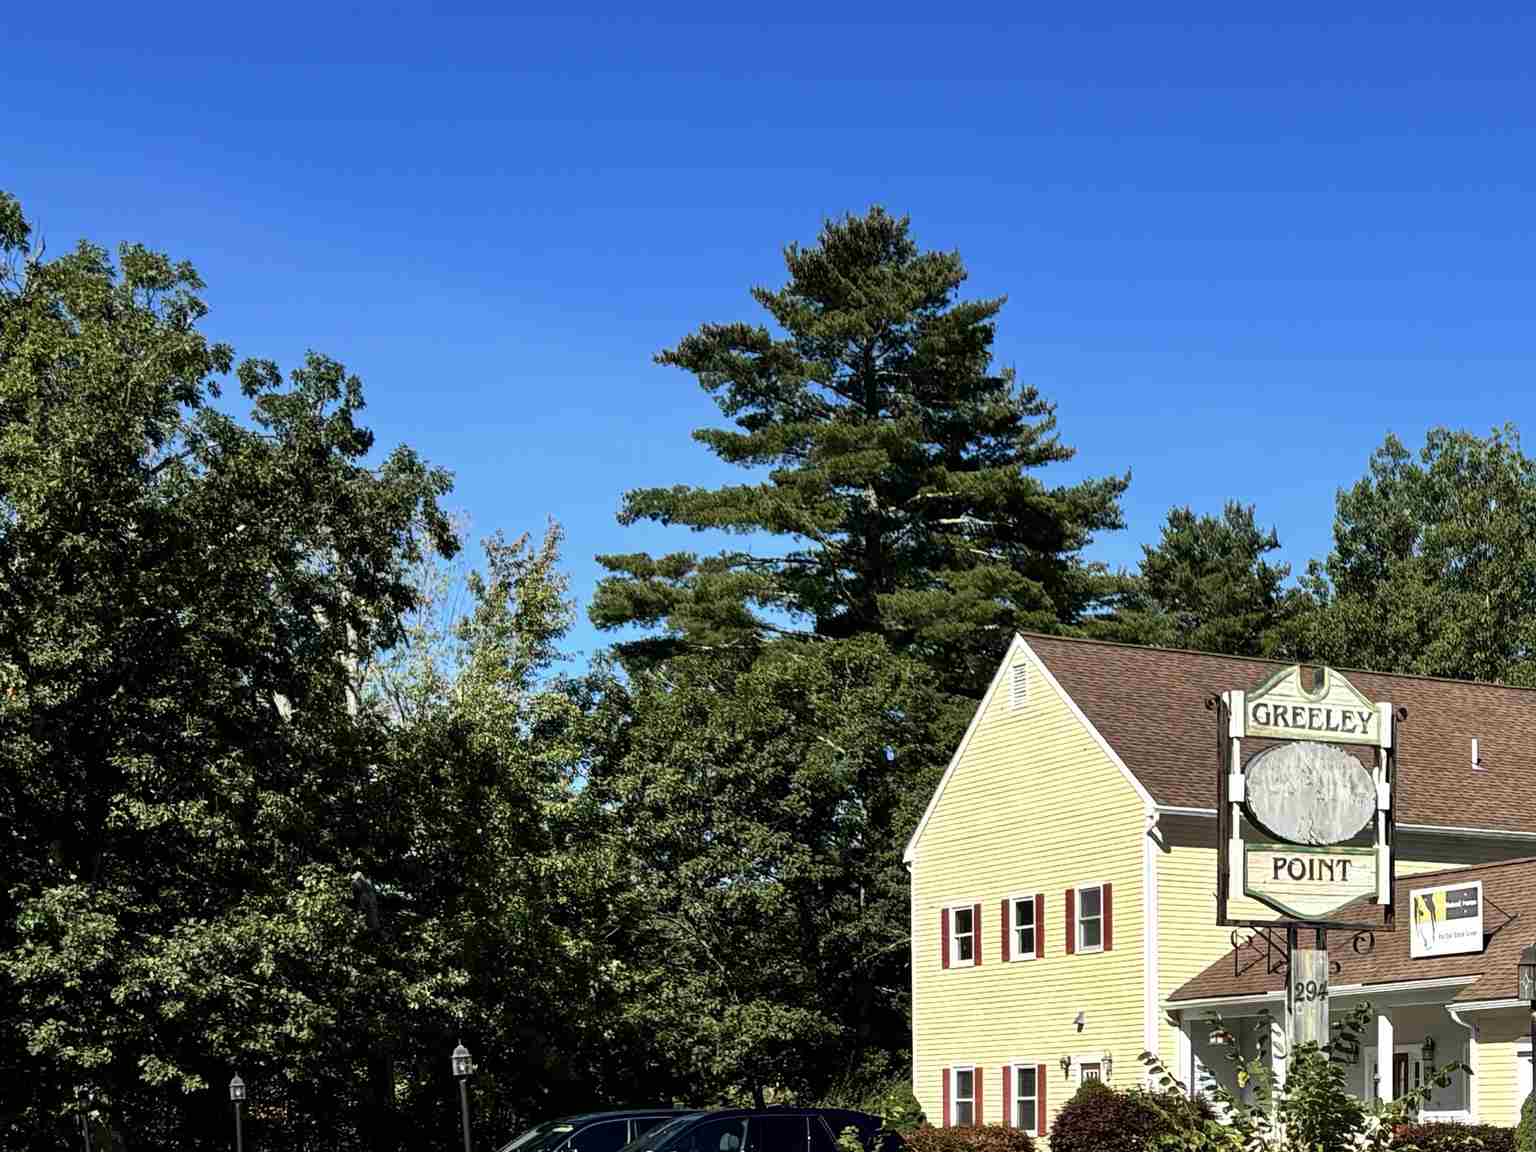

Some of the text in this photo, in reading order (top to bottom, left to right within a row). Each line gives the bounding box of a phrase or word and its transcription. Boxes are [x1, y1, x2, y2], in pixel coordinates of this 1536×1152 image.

[1251, 702, 1374, 735] GREELEY
[1271, 857, 1352, 882] POINT
[1295, 980, 1328, 1002] 294
